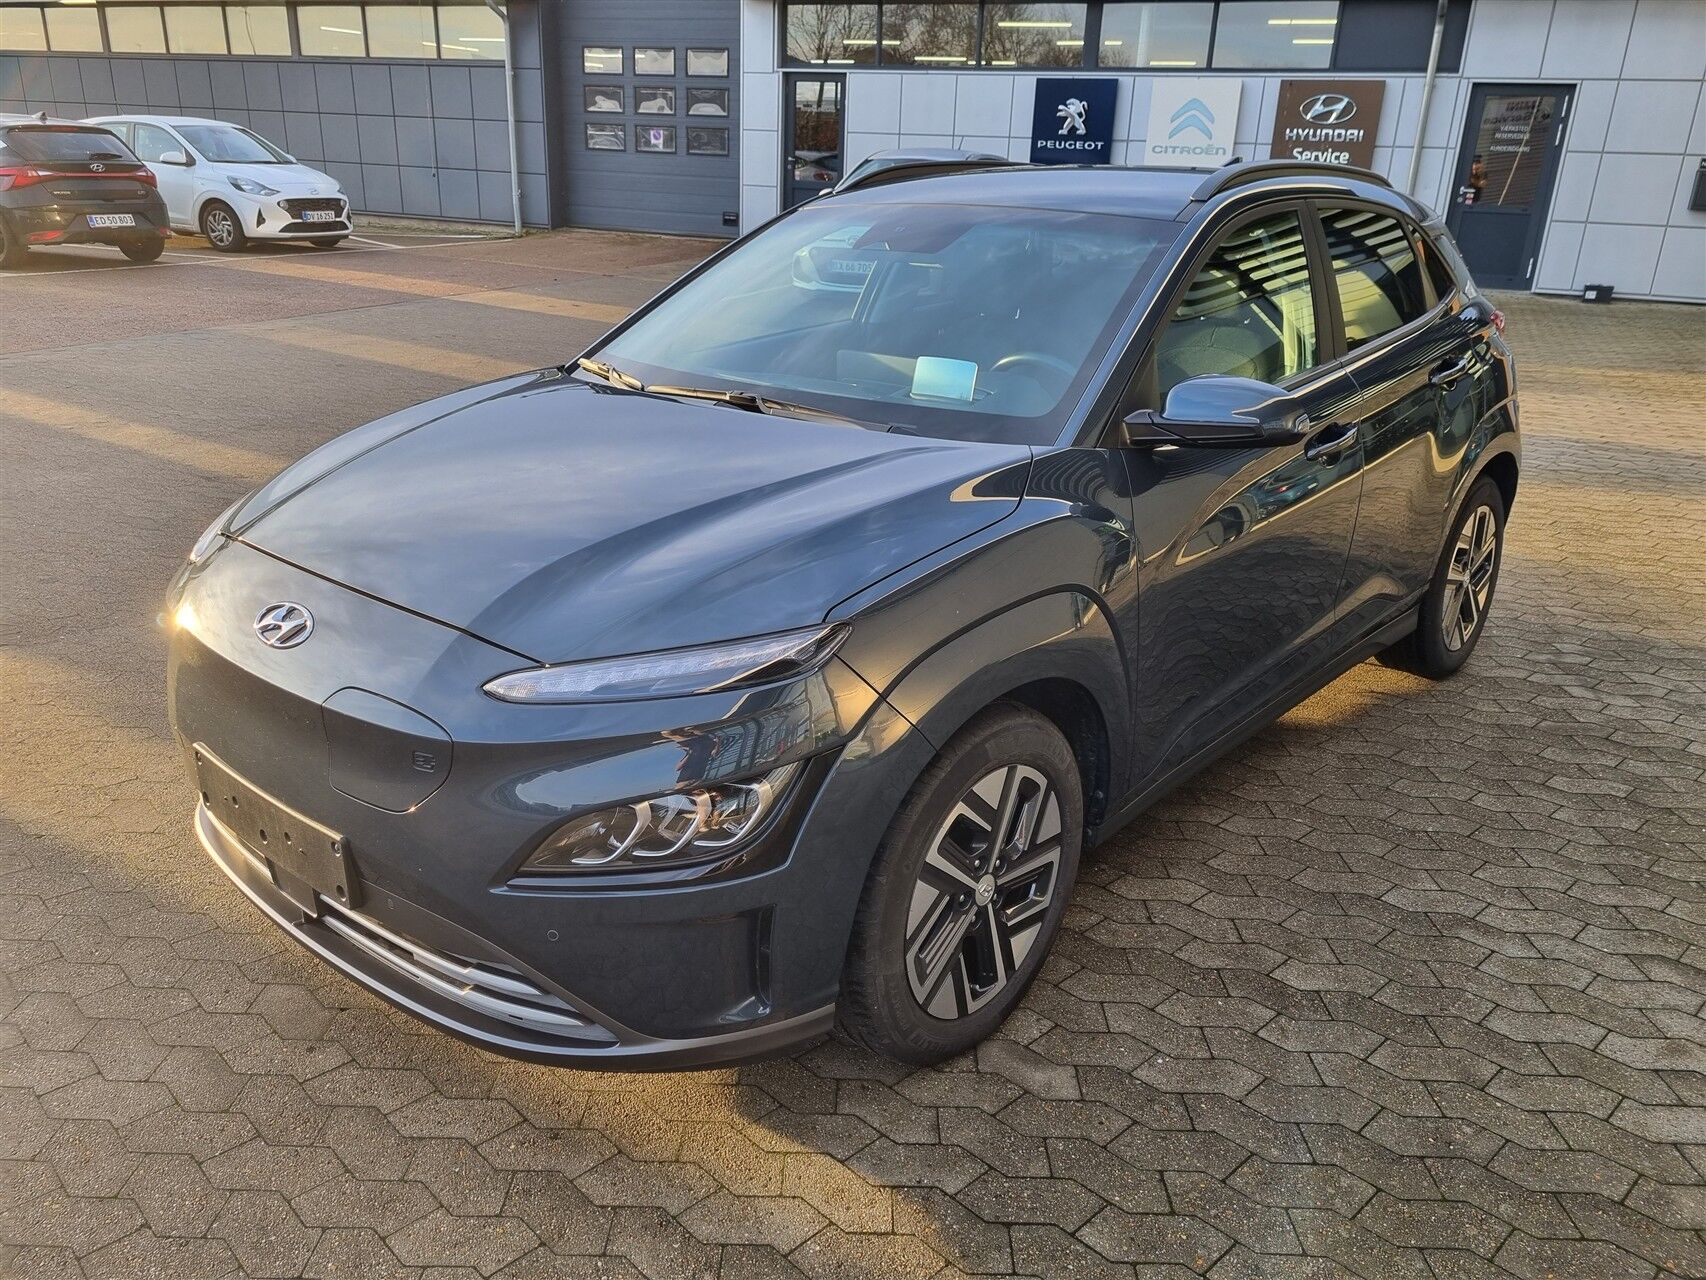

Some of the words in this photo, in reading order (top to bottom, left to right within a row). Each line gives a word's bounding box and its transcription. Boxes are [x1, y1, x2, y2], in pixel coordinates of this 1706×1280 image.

[1285, 128, 1364, 142] HYUNDAI
[1037, 140, 1105, 150] PEUGEOT
[1151, 144, 1226, 156] CITROËN
[1292, 147, 1350, 164] Service
[94, 216, 106, 225] ED
[107, 216, 118, 225] 50
[119, 215, 134, 225] 803
